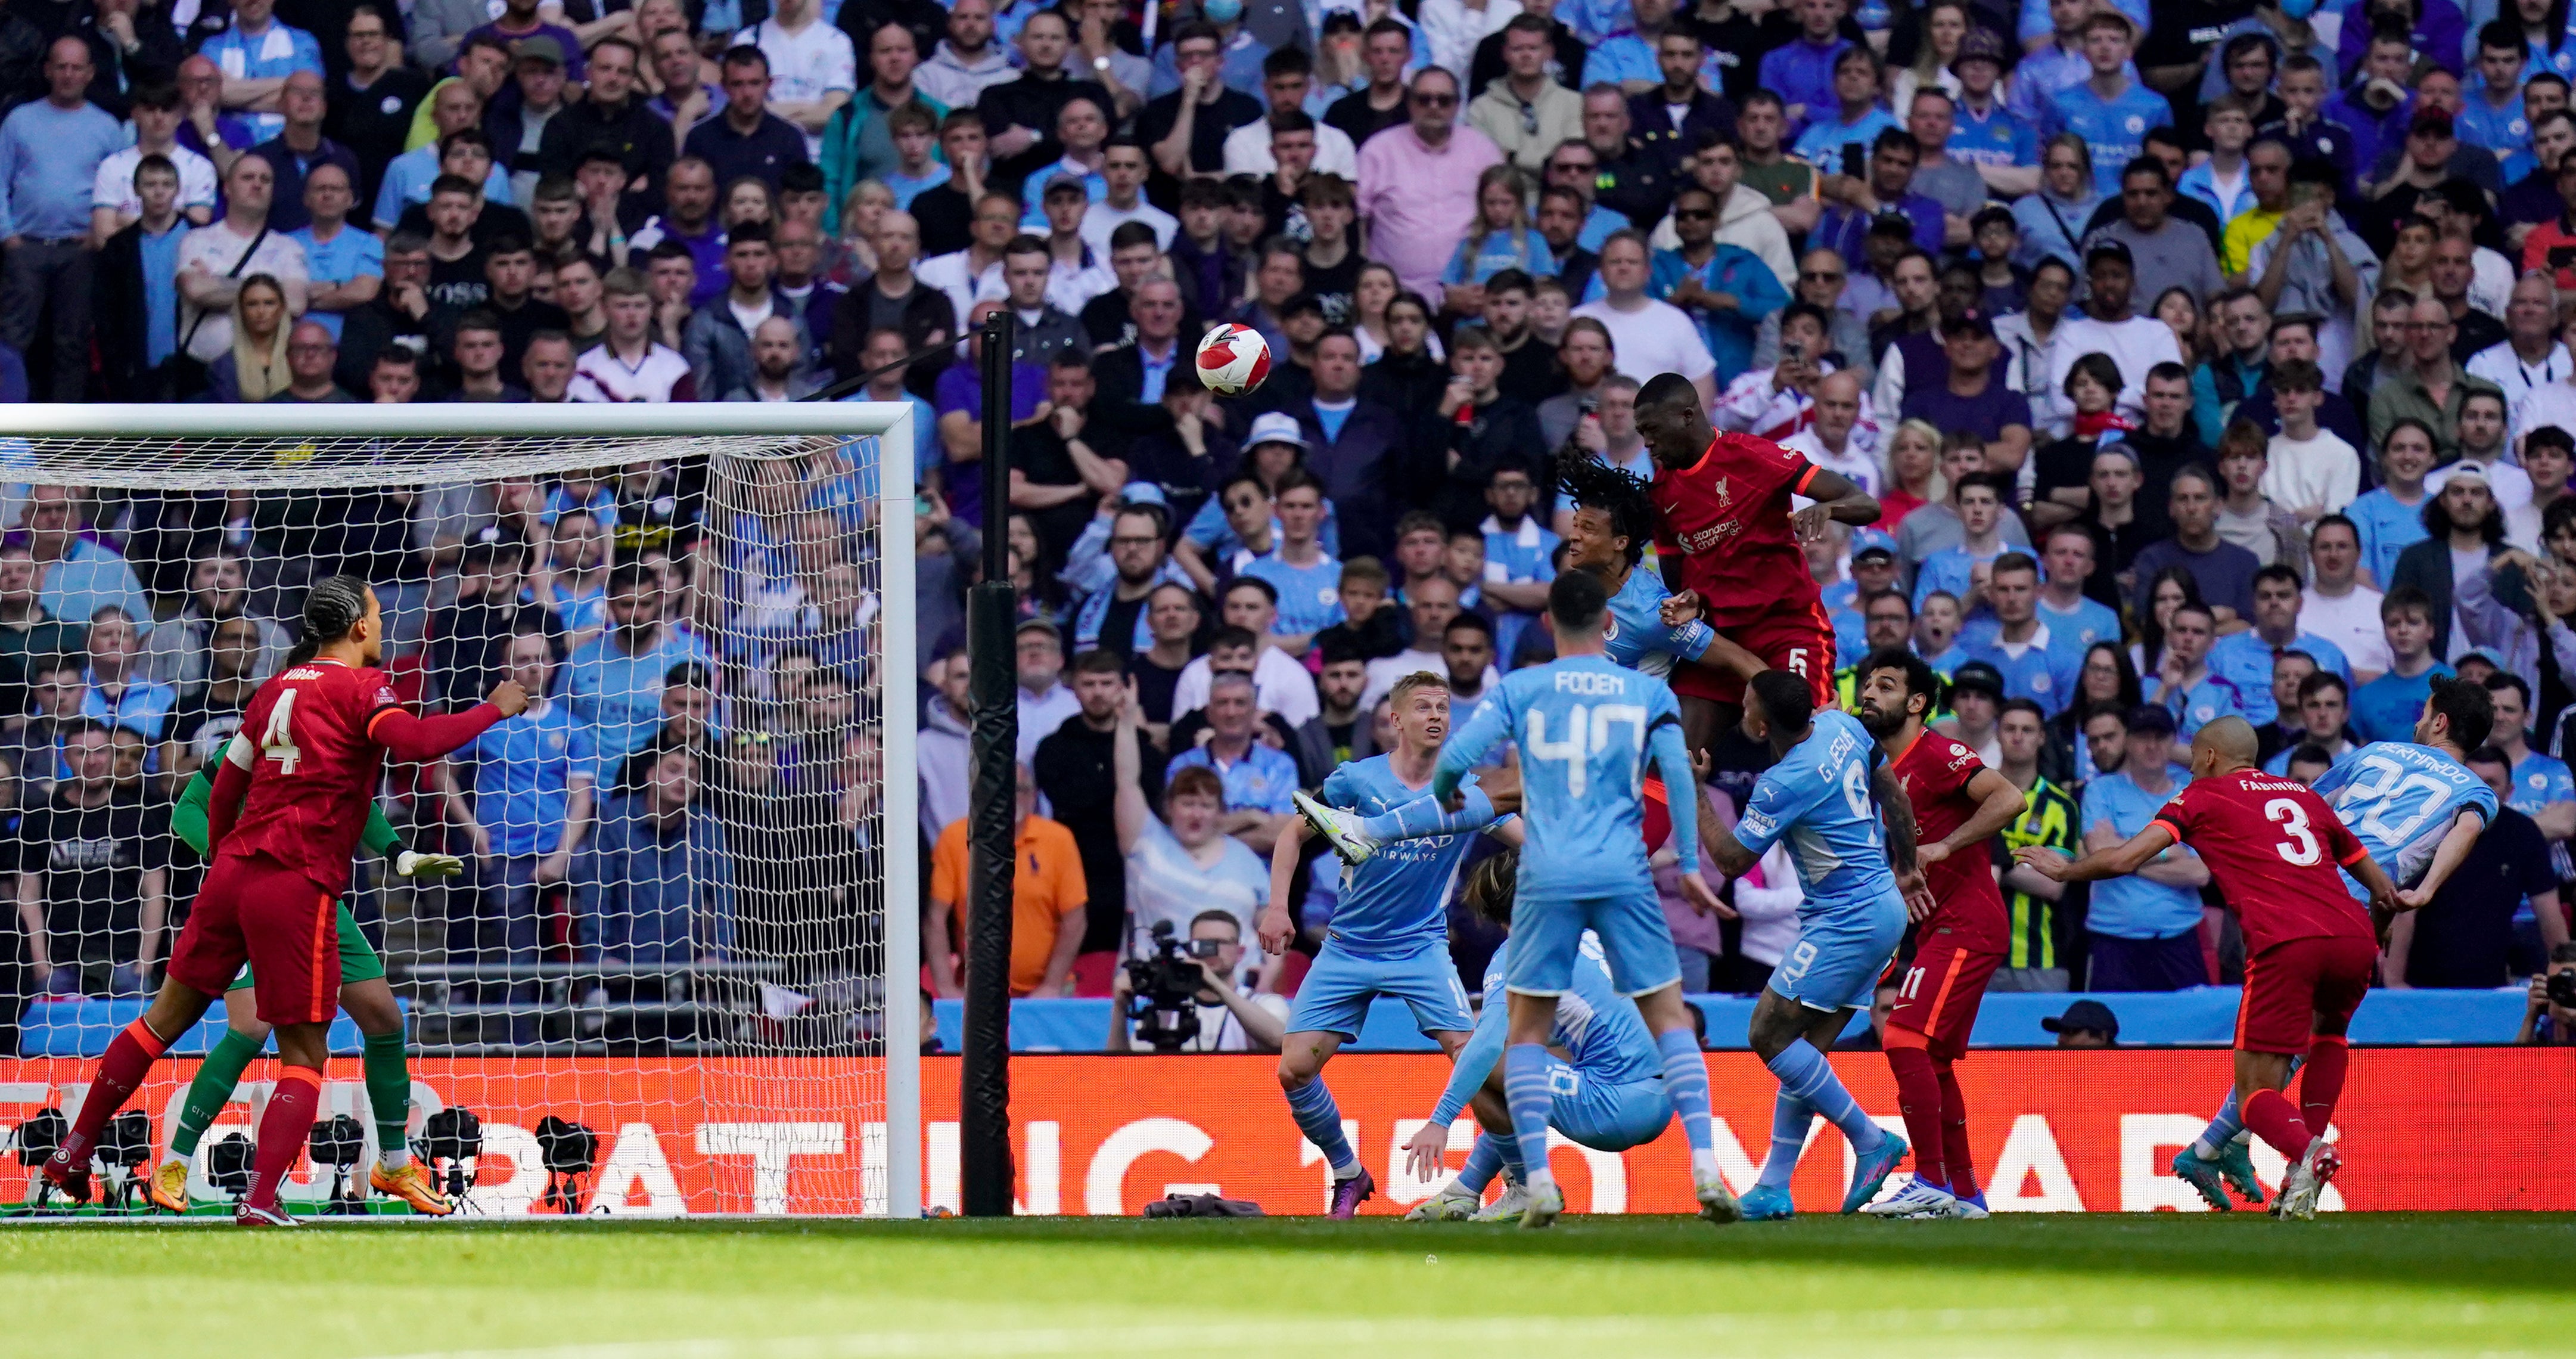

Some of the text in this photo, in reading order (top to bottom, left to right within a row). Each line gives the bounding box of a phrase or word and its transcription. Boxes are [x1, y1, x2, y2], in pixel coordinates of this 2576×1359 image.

[434, 282, 487, 305] OSS
[1692, 519, 1739, 542] standard
[1682, 621, 1700, 643] TIRE
[1789, 648, 1808, 679] 5
[1555, 671, 1624, 696] FODEN
[261, 688, 301, 775] 4
[1818, 727, 1856, 784] G. JESUS
[2376, 742, 2470, 784] BERNARDO
[2239, 780, 2307, 793] FABINHO
[2334, 755, 2452, 846] 20
[1744, 817, 1768, 834] TIRE
[1747, 805, 1777, 829] NEXEN
[2264, 798, 2322, 867] 3
[1372, 848, 1437, 862] AIRWAYS
[1785, 940, 1818, 978] 9
[1899, 966, 1926, 1000] 11
[192, 1105, 215, 1121] CITY
